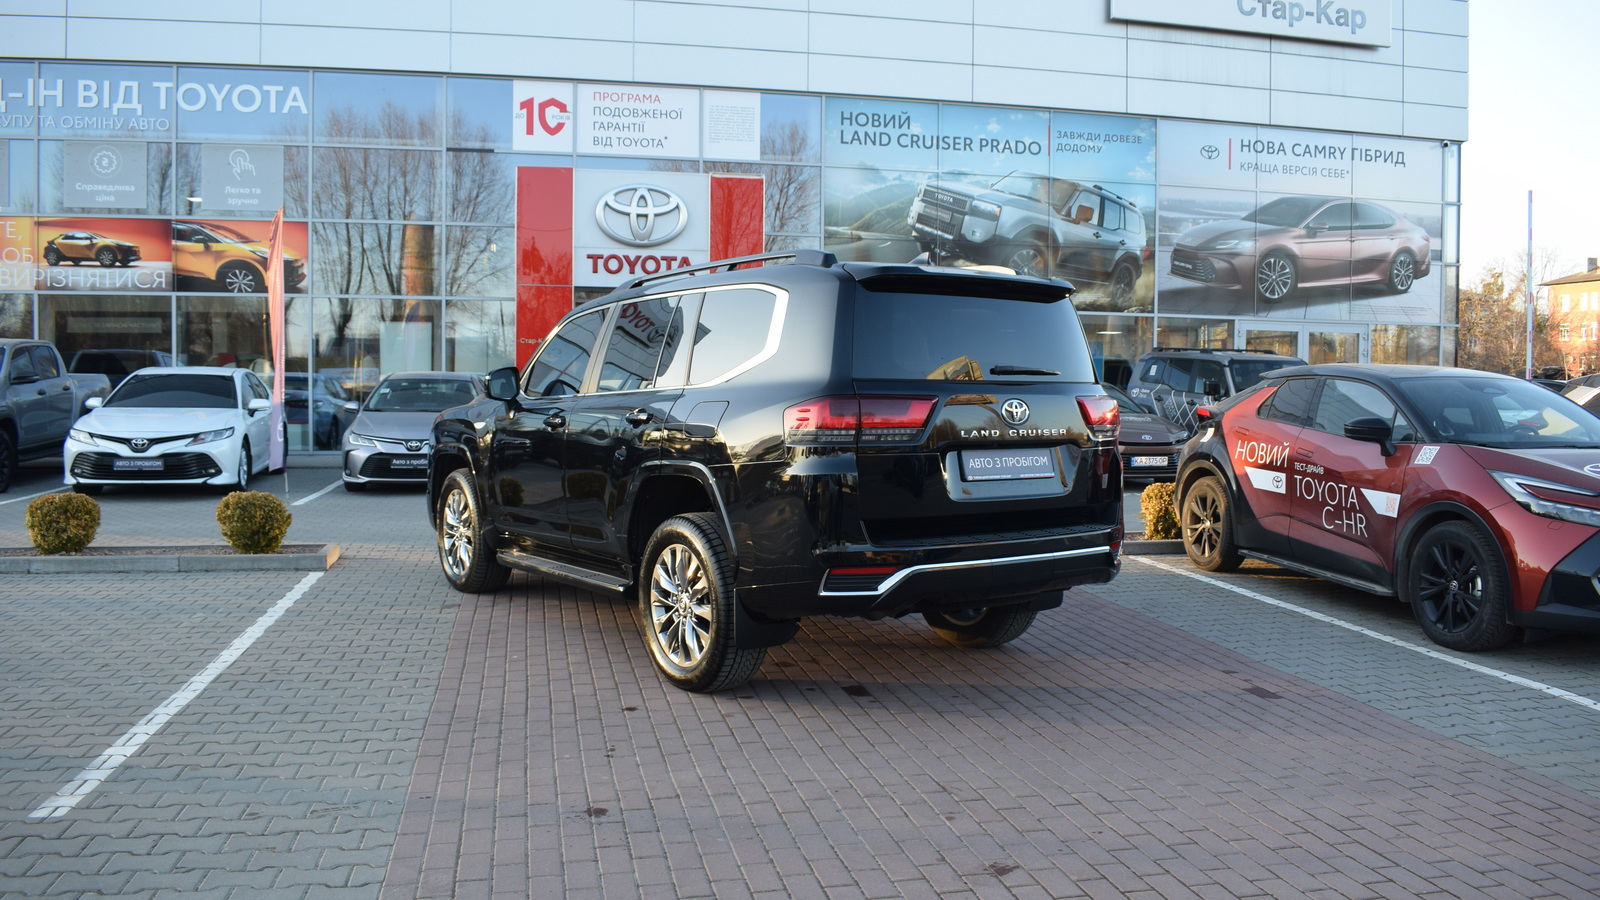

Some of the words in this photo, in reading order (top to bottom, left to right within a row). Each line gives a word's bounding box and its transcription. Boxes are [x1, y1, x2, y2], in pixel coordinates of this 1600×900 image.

[1236, 0, 1367, 35] Стар-Кар
[77, 78, 143, 115] ВІД
[152, 81, 309, 115] TOYOTA
[592, 91, 662, 105] ПРОГРАМА
[592, 106, 683, 120] ПОДОВЖЕНОЇ
[839, 110, 912, 130] НОВИЙ
[0, 114, 34, 128] УПУ
[38, 115, 56, 128] ТА
[60, 115, 124, 130] ОБМІНУ
[128, 116, 170, 131] АВТО
[592, 120, 646, 133] ГАРАНТІЇ
[592, 136, 613, 149] ВІД
[839, 130, 892, 148] LAND
[896, 133, 974, 152] CRUISER
[979, 139, 1042, 156] PRADO
[1056, 130, 1101, 142] ЗАВЖДИ
[1103, 132, 1143, 145] ДОВЕЗЕ
[1055, 142, 1103, 155] ДОДОМУ
[1239, 138, 1287, 156] НОВА
[1291, 142, 1347, 161] CAMRY
[1350, 147, 1406, 168] ГІБРИД
[1239, 161, 1279, 176] КРАЩА
[1282, 164, 1318, 177] ВЕРСІЯ
[75, 182, 135, 192] Справедлива
[224, 186, 250, 195] Легко
[95, 194, 115, 202] ціна
[227, 198, 259, 206] зручно
[586, 253, 696, 276] TOYOTA
[0, 267, 167, 289] ВИРІЗНЯТИСЯ
[961, 429, 1000, 438] LAND
[1008, 428, 1067, 437] CRUISER
[1144, 457, 1159, 465] 2375
[1234, 440, 1290, 468] НОВИЙ
[968, 457, 993, 469] АВТО
[1002, 456, 1048, 467] ПРОБІГОМ
[1294, 462, 1325, 475] ТЕСТ-ДРАЙВ
[1294, 475, 1360, 510] TOYOTA
[1322, 506, 1368, 538] C-HR
